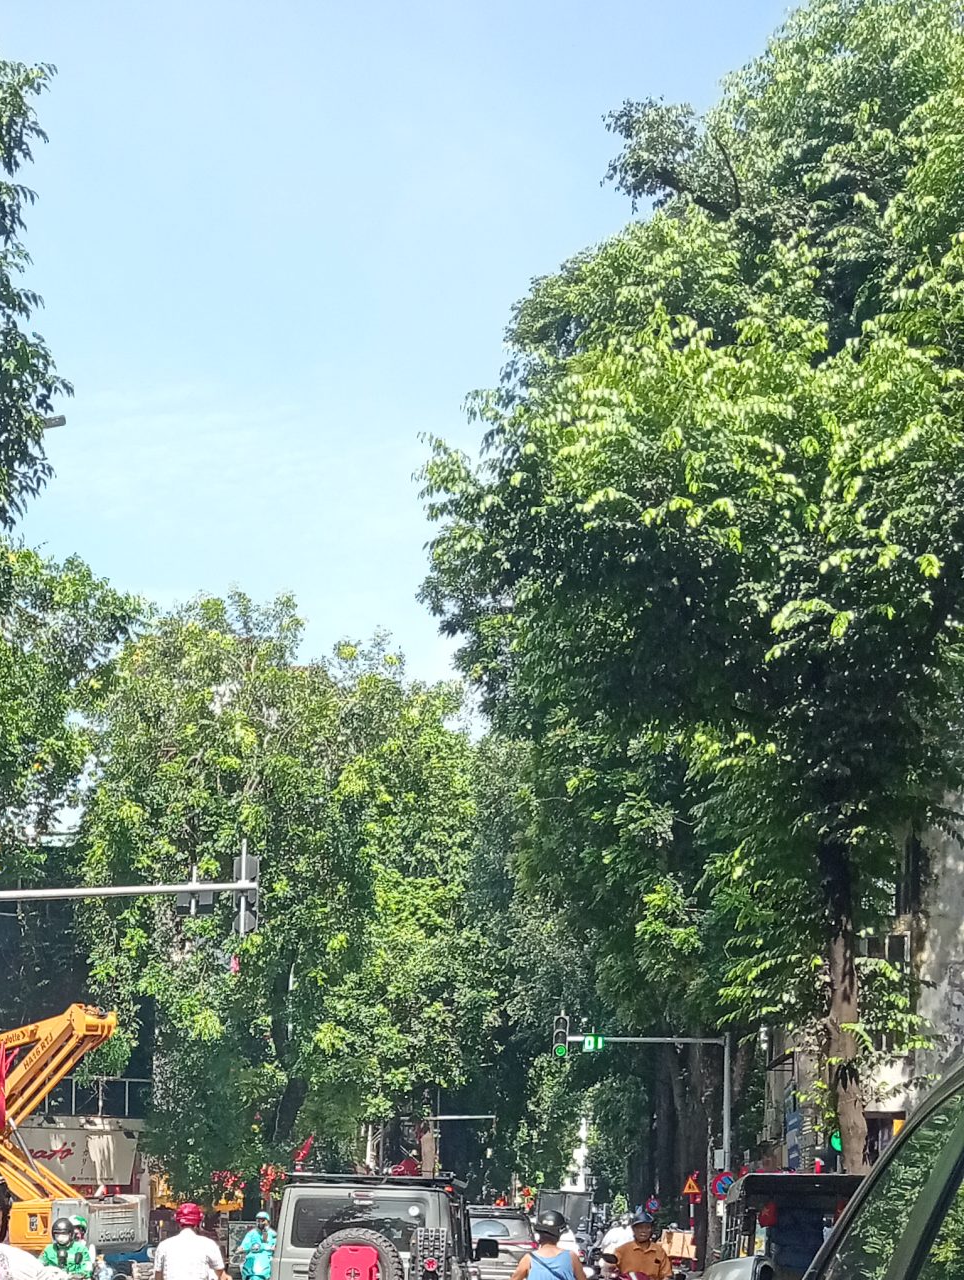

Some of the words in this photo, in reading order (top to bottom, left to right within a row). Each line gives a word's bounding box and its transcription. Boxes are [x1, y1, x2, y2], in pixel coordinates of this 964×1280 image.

[23, 1047, 41, 1070] HA16
[41, 1032, 54, 1050] RTJ
[584, 1035, 603, 1050] 01
